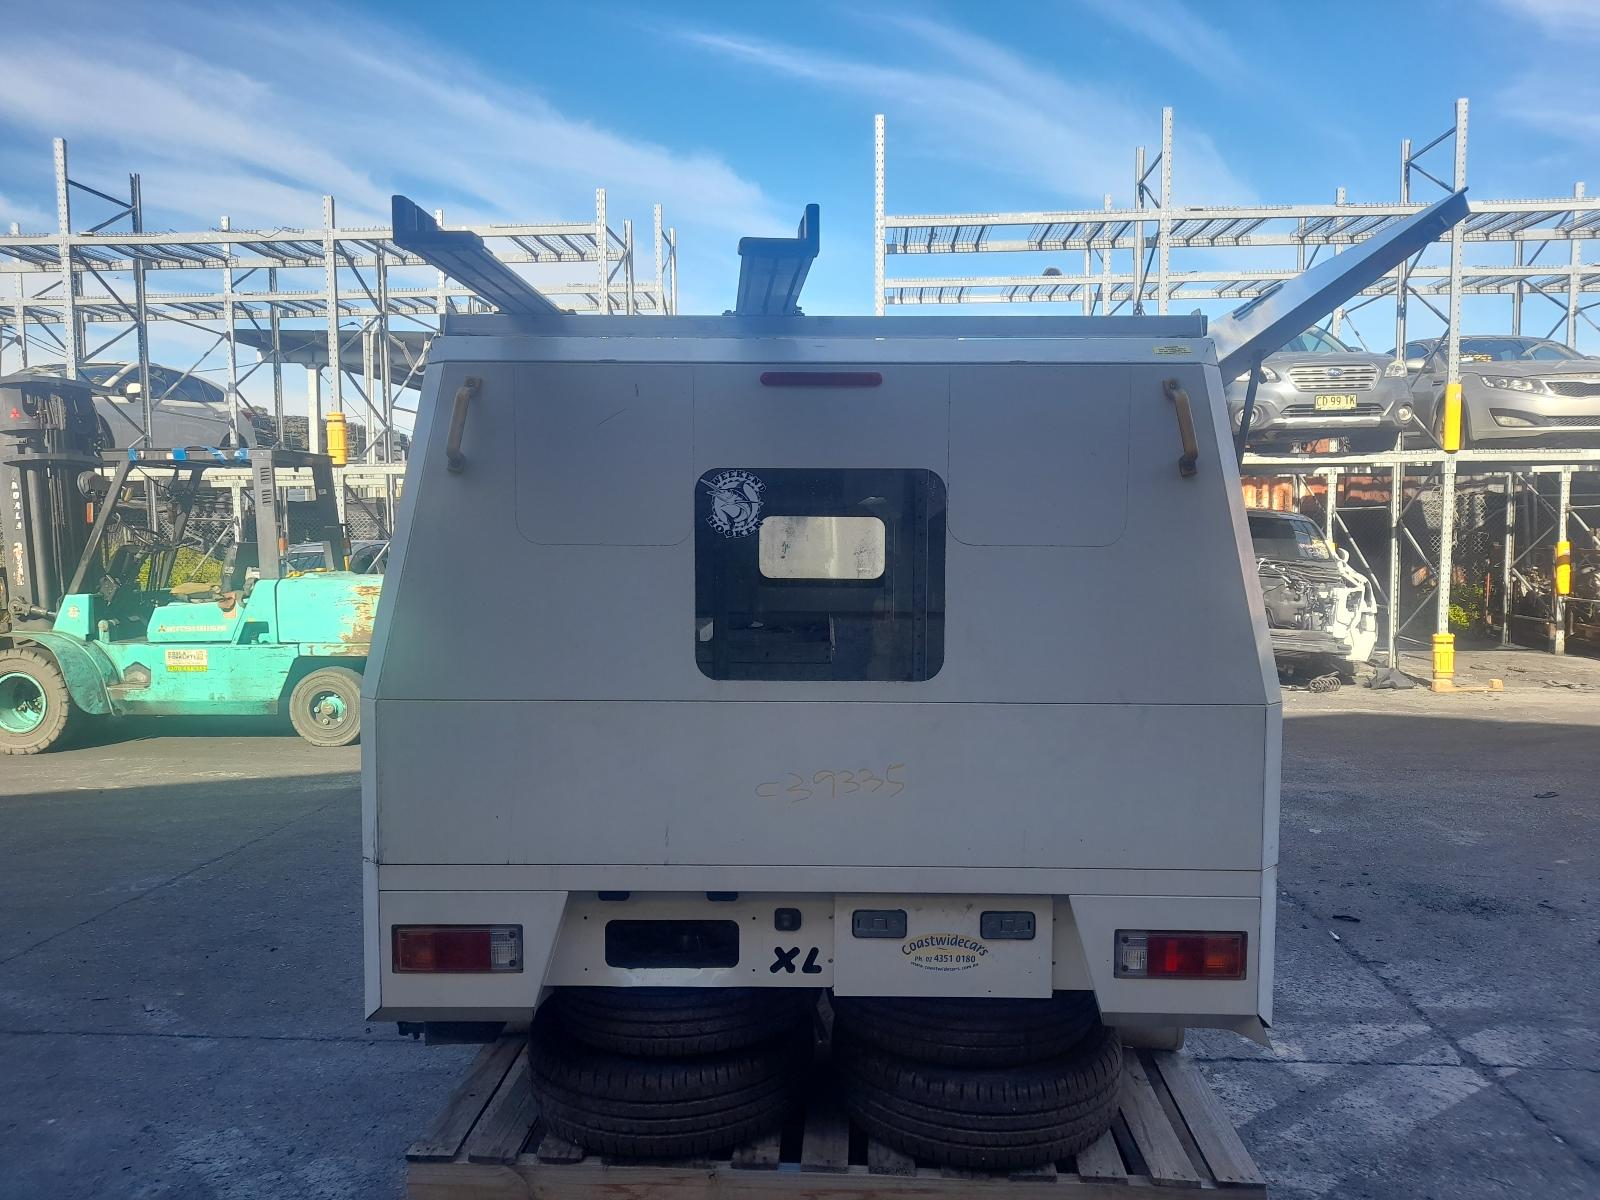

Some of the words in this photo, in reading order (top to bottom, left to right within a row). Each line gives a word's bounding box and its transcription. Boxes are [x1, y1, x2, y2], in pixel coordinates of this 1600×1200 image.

[1330, 397, 1342, 406] 99
[711, 469, 766, 492] WEEKEND
[706, 515, 764, 538] HOOKER
[902, 934, 989, 956] Coastwidecars
[770, 947, 822, 973] XL
[934, 954, 953, 963] 4351
[955, 954, 976, 963] 0180
